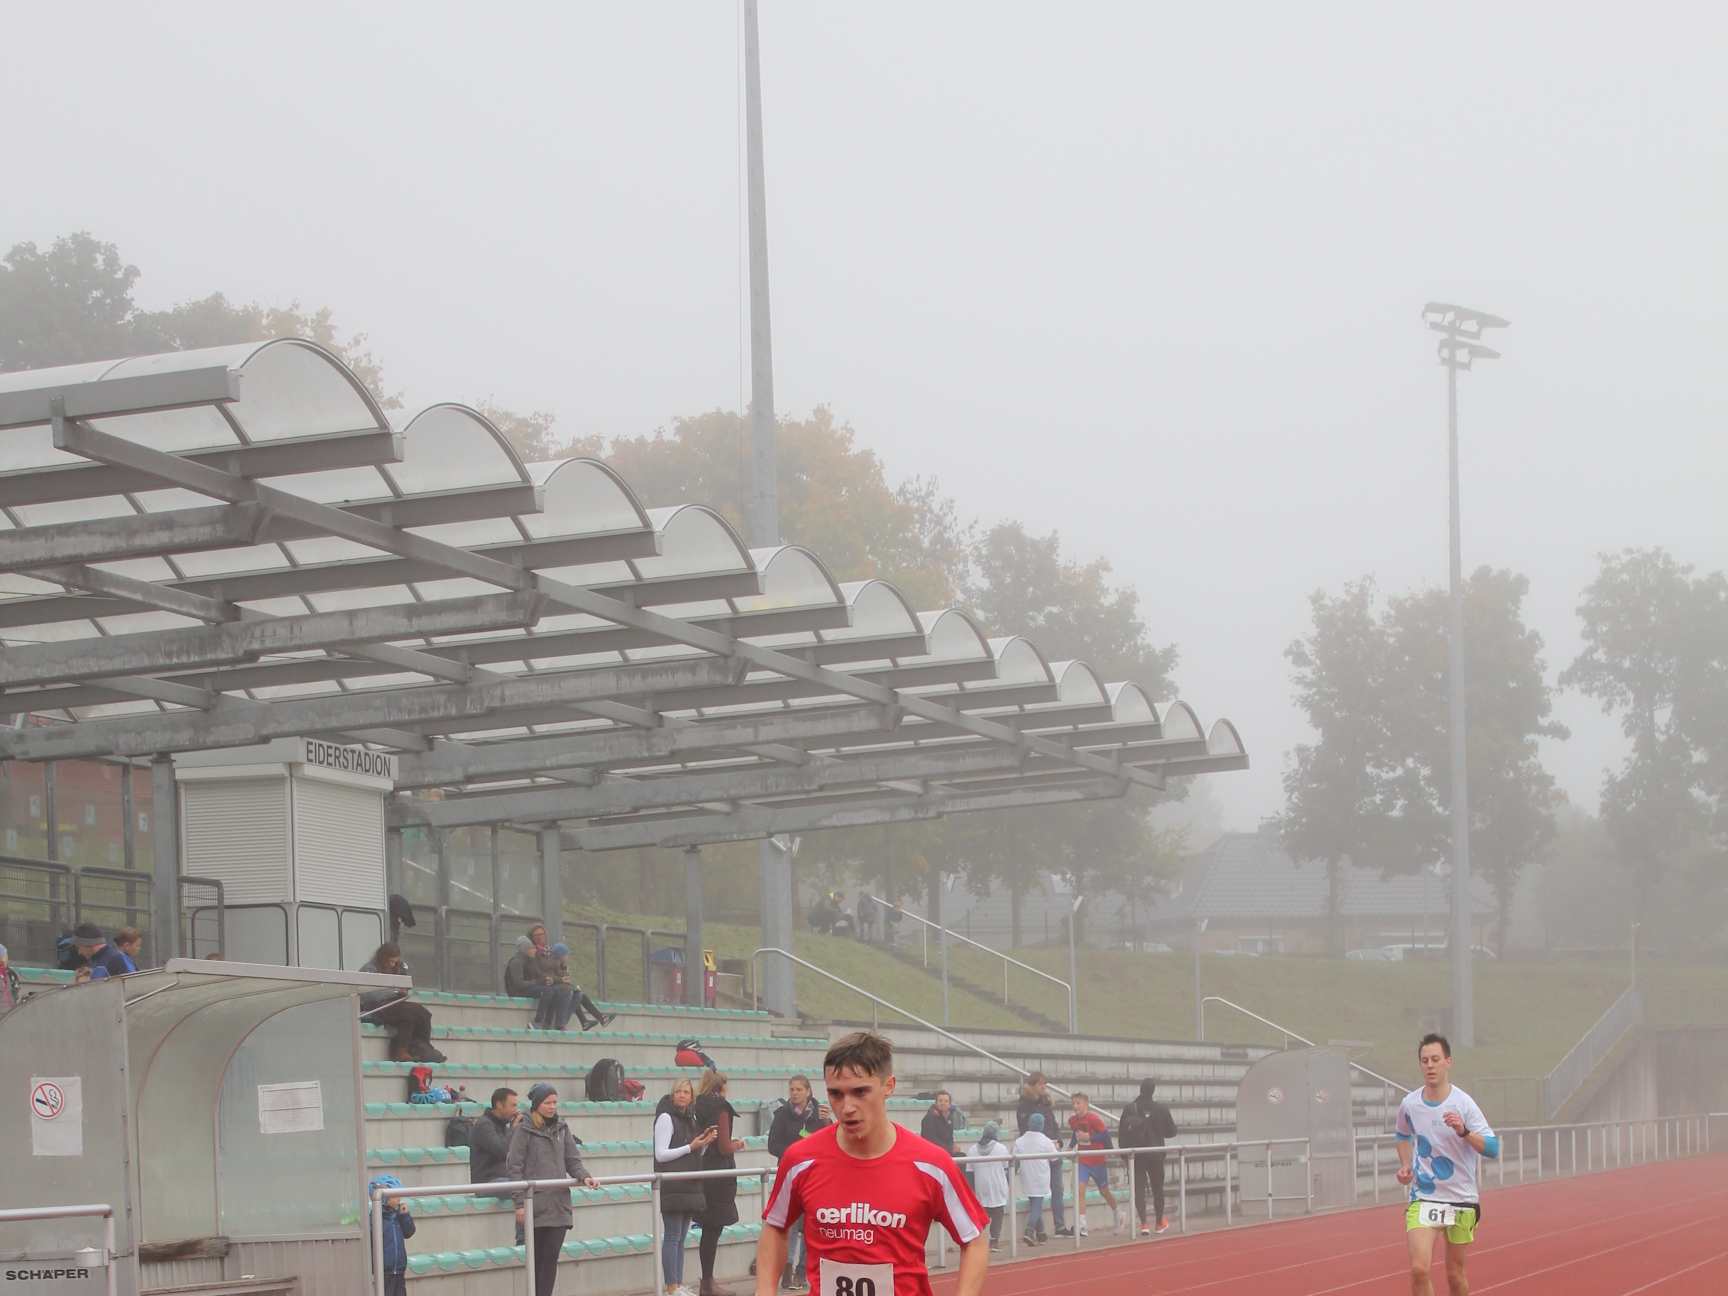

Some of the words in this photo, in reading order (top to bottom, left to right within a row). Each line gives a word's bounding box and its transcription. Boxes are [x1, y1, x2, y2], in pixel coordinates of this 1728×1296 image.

[306, 741, 391, 777] EIDERSTADION
[1428, 1208, 1446, 1222] 61
[820, 1227, 874, 1244] neumag
[6, 1268, 89, 1280] SCHÄPER
